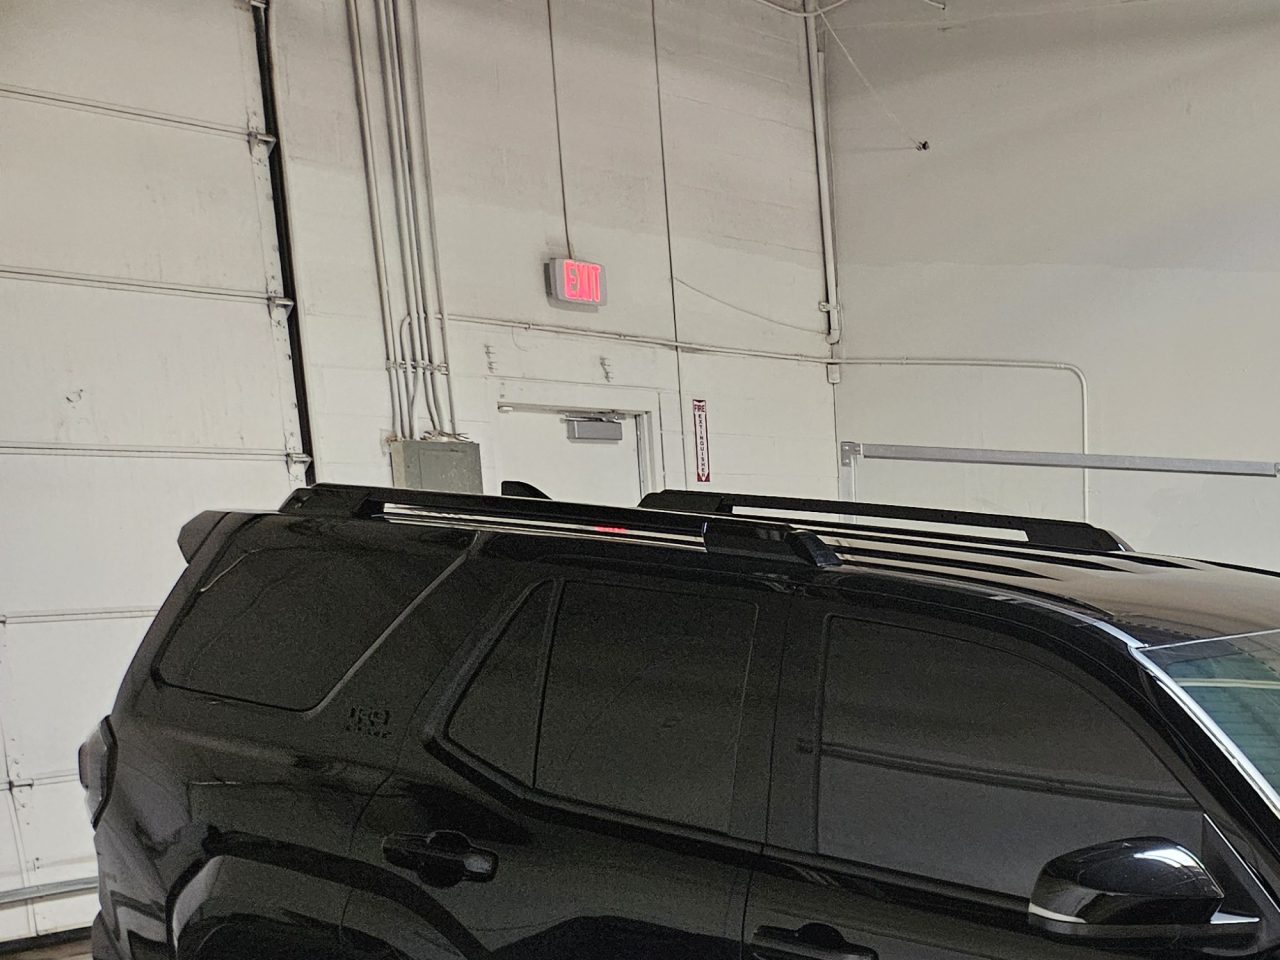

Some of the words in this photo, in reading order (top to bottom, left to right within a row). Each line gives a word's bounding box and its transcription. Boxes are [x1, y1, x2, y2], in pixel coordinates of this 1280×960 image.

[564, 259, 601, 303] EXIT
[694, 404, 706, 413] FIRE
[698, 413, 706, 478] EXTINGUISHER
